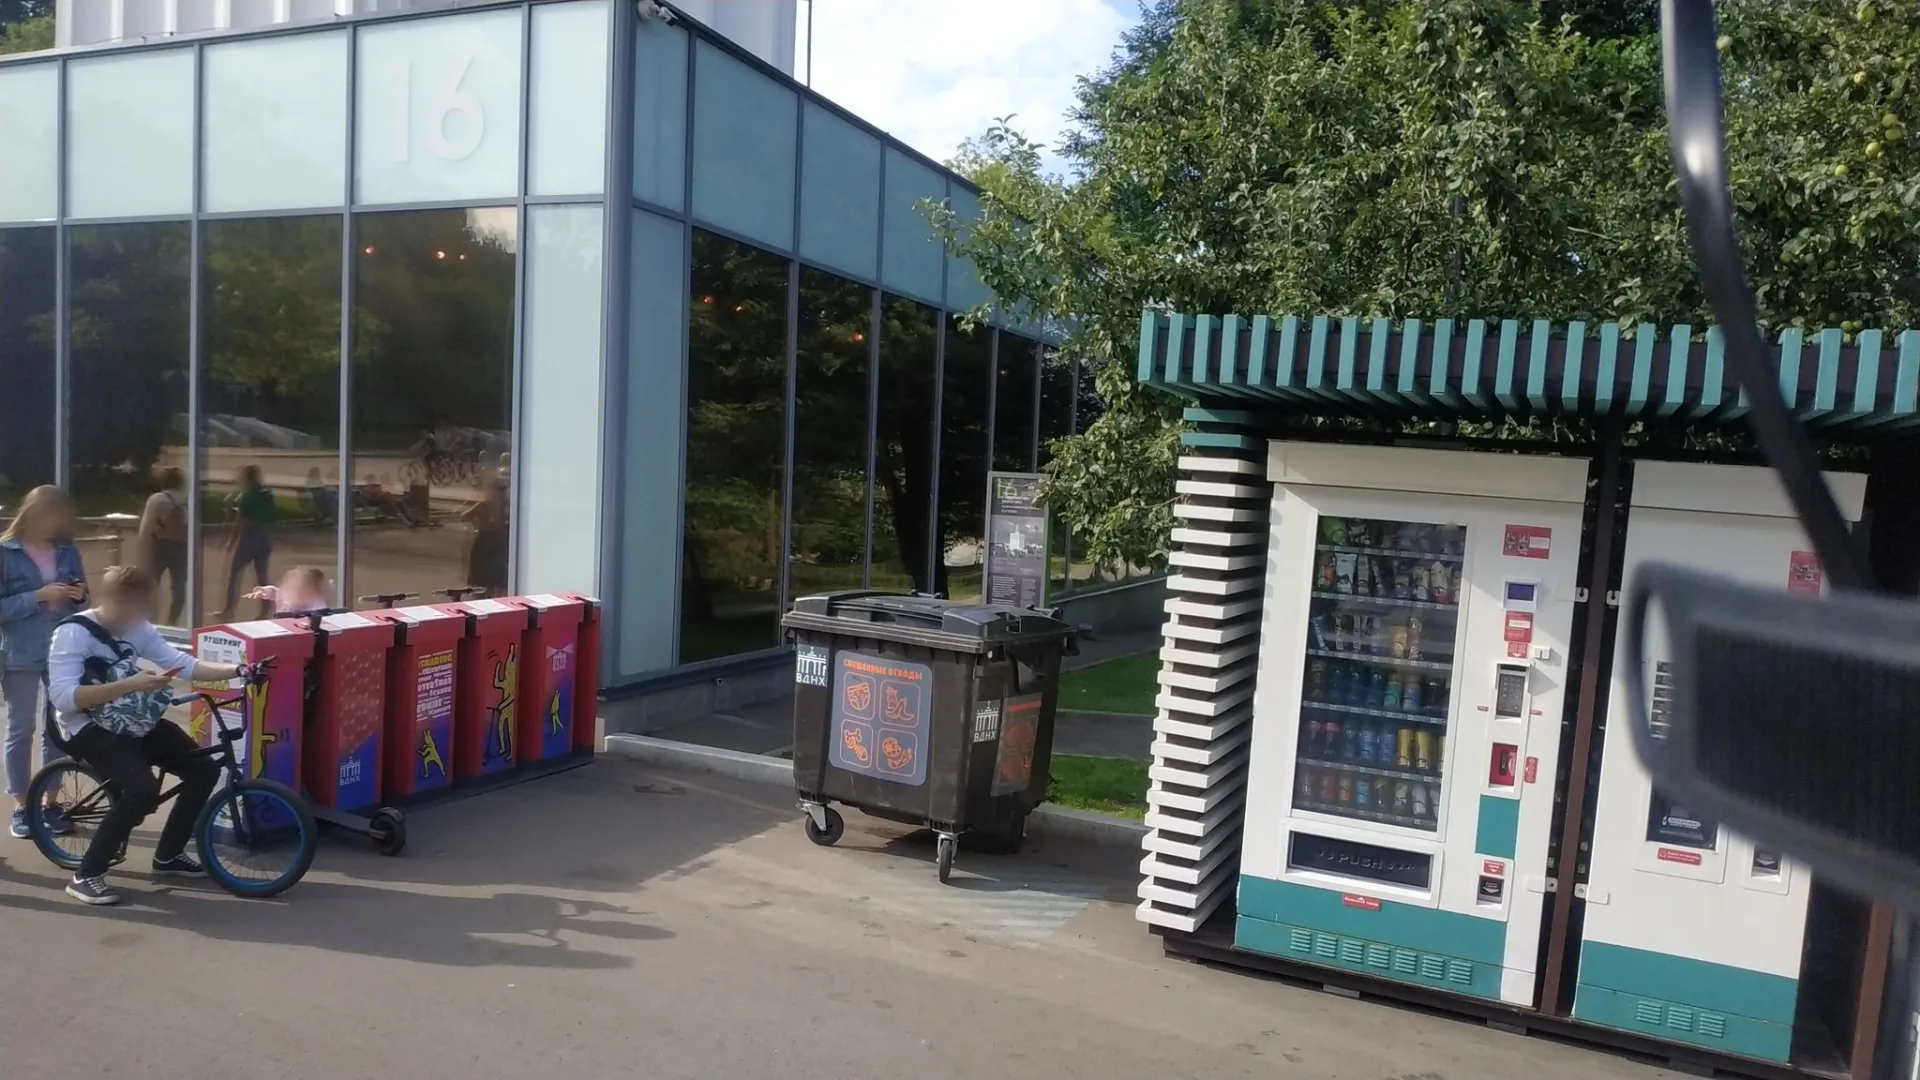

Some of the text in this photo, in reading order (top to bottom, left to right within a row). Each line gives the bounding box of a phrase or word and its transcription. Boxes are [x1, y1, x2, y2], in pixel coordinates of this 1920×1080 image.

[393, 53, 486, 163] 16
[796, 672, 826, 687] ВДНХ
[888, 667, 923, 680] ОТХОДЫ
[974, 730, 997, 743] ВДНХ
[1338, 852, 1383, 870] PUSH
